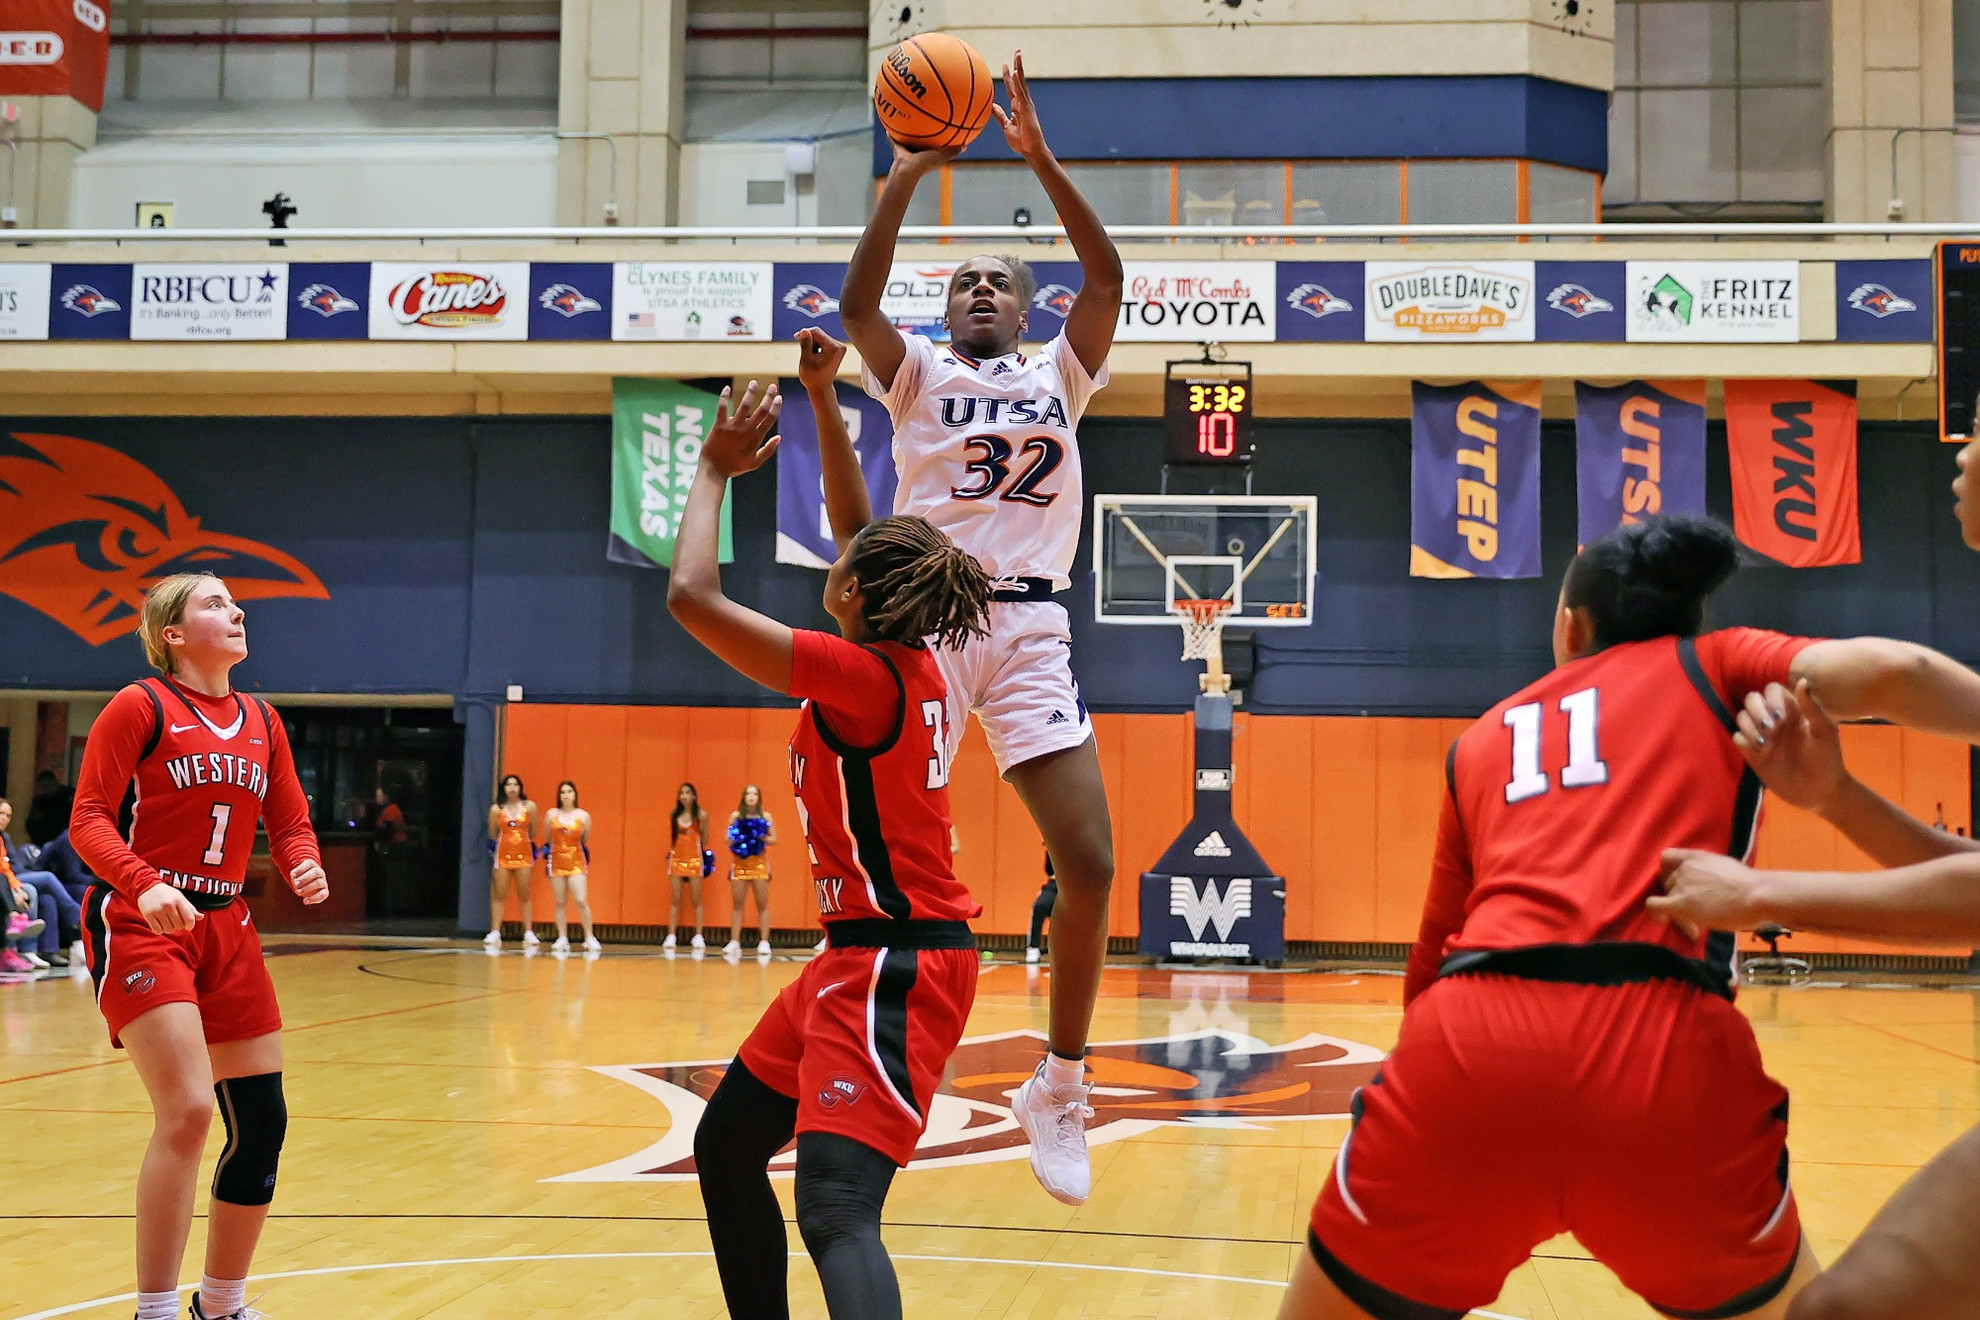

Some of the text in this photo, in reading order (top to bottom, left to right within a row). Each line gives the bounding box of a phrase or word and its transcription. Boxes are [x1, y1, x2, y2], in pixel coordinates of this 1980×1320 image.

[141, 275, 251, 304] RBFCU
[627, 270, 760, 285] CLYNES FAMILY
[1131, 276, 1168, 306] Red
[1713, 279, 1793, 300] FRITZ
[393, 271, 508, 325] Cane's
[648, 298, 747, 308] UTSA ATHLETICS
[1121, 301, 1266, 325] TOYOTA
[1701, 303, 1793, 319] KENNEL
[939, 395, 1069, 429] UTSA
[1189, 385, 1247, 412] 3:32
[1198, 412, 1234, 457] 10
[640, 412, 671, 540] TEXAS
[951, 433, 1065, 508] 32
[1456, 395, 1498, 562] UTEP
[1770, 400, 1818, 542] WKU
[921, 695, 950, 790] 3
[1503, 686, 1608, 805] 11
[203, 802, 232, 867] 1
[833, 1080, 856, 1095] WKU
